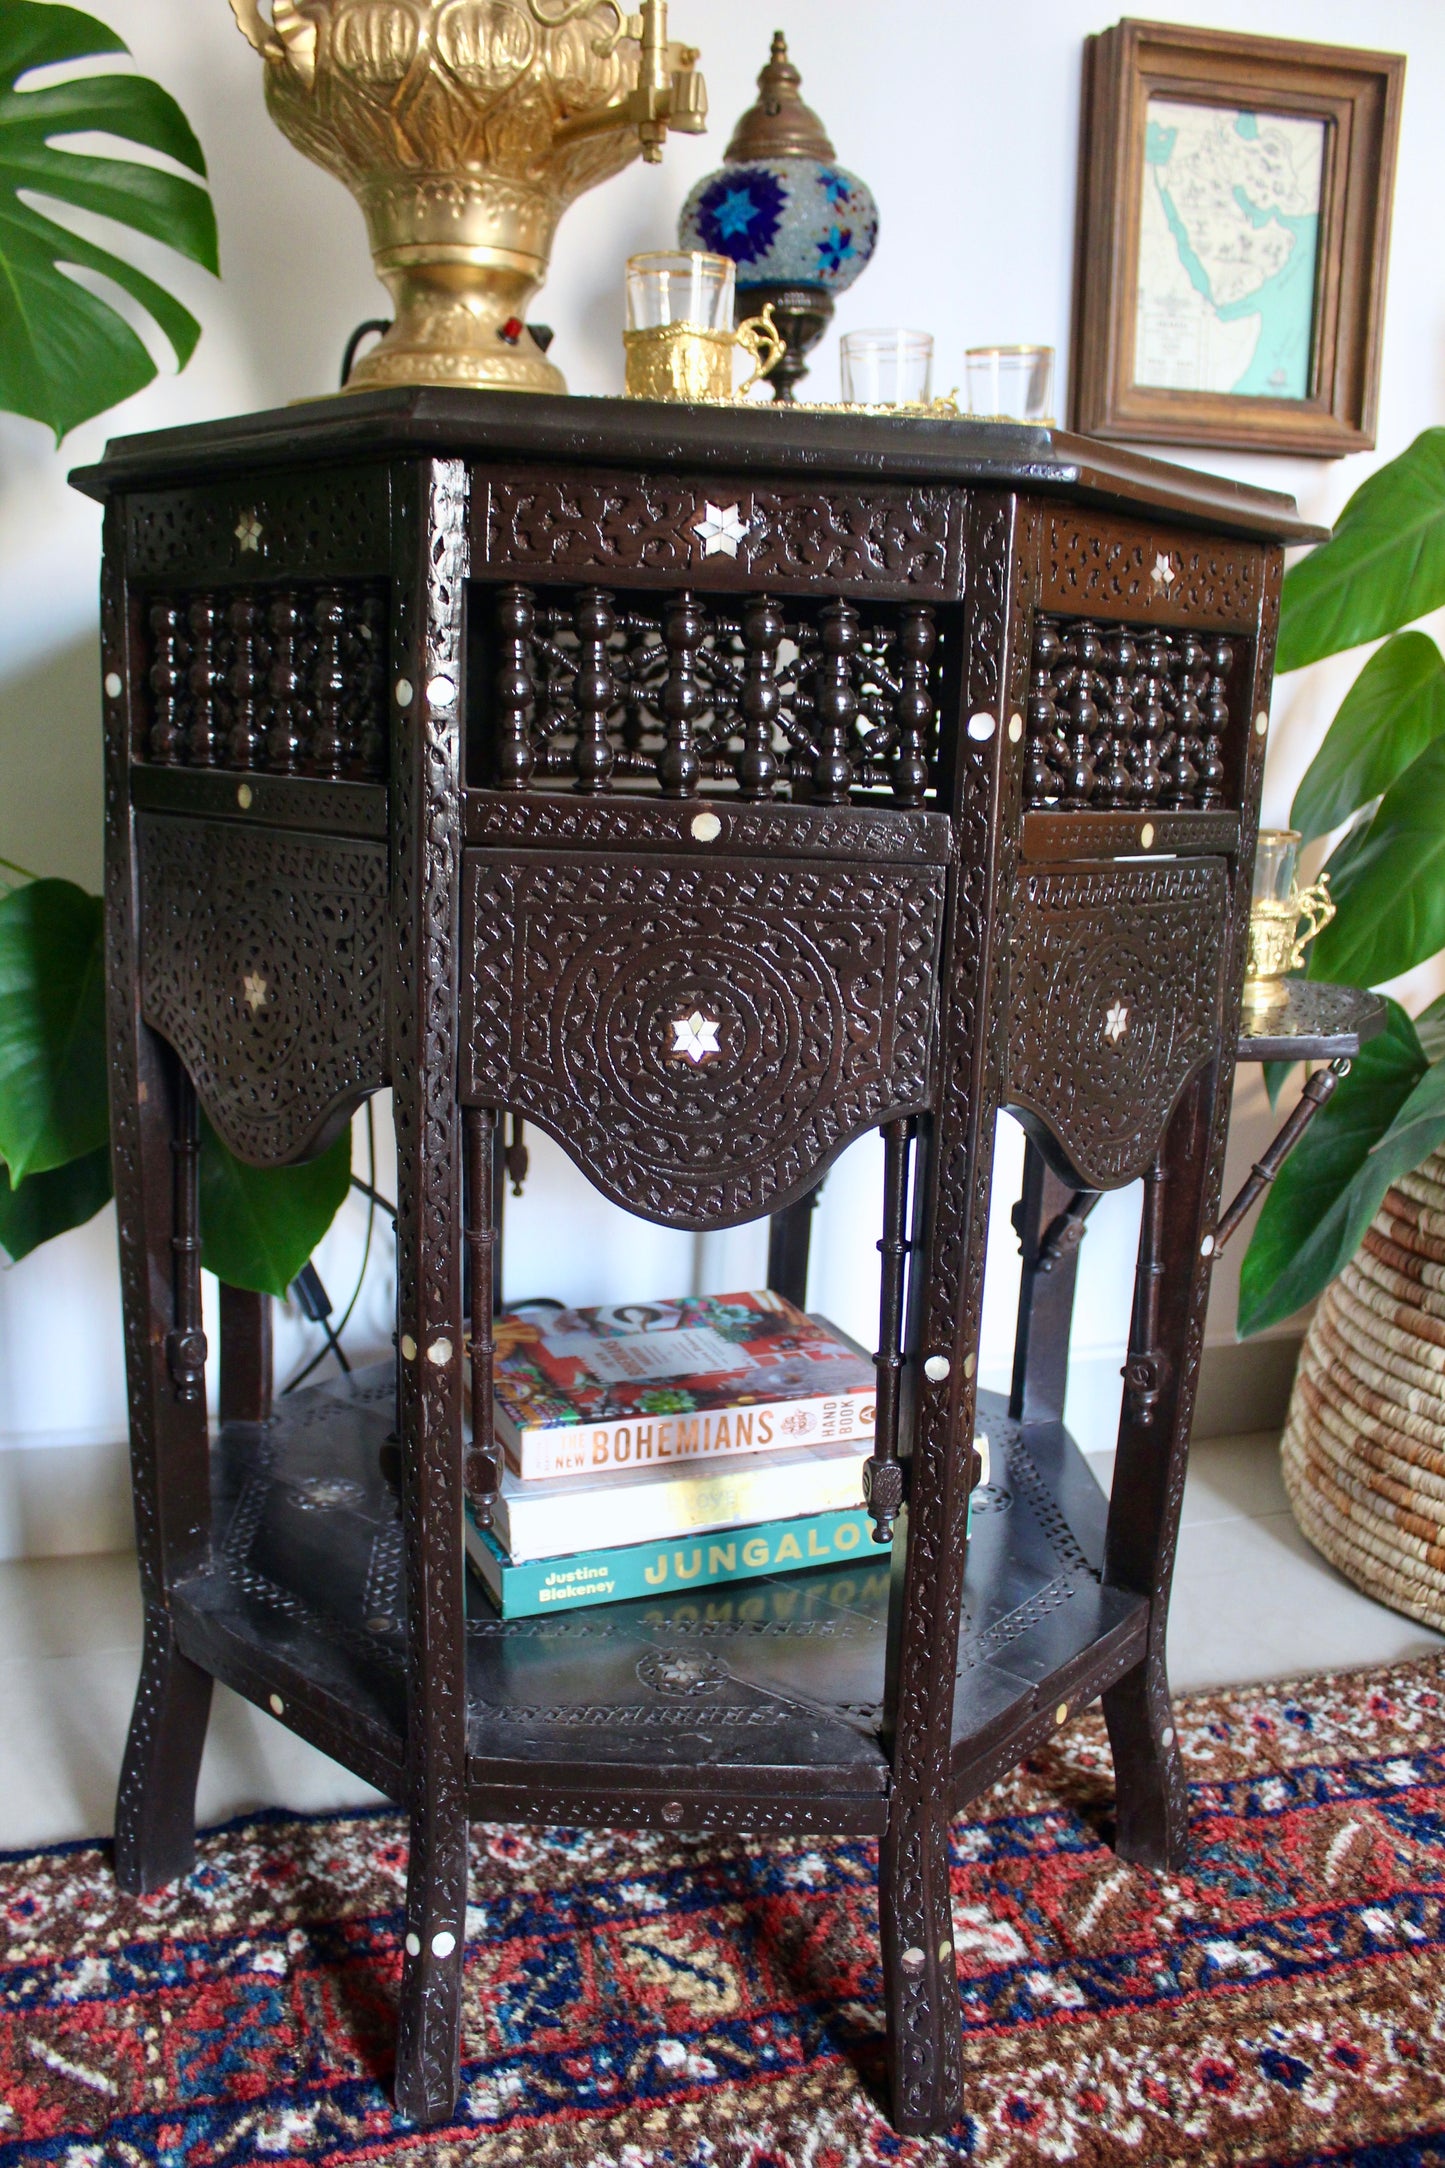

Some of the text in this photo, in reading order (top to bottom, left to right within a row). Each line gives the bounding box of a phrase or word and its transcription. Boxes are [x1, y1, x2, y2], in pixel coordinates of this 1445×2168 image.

[822, 1401, 837, 1437] HAND
[839, 1399, 854, 1435] BOOK
[591, 1410, 775, 1465] BOHEMIANS
[555, 1452, 585, 1469] NEW
[538, 1580, 616, 1602] Blakeney
[545, 1566, 609, 1591] Justina
